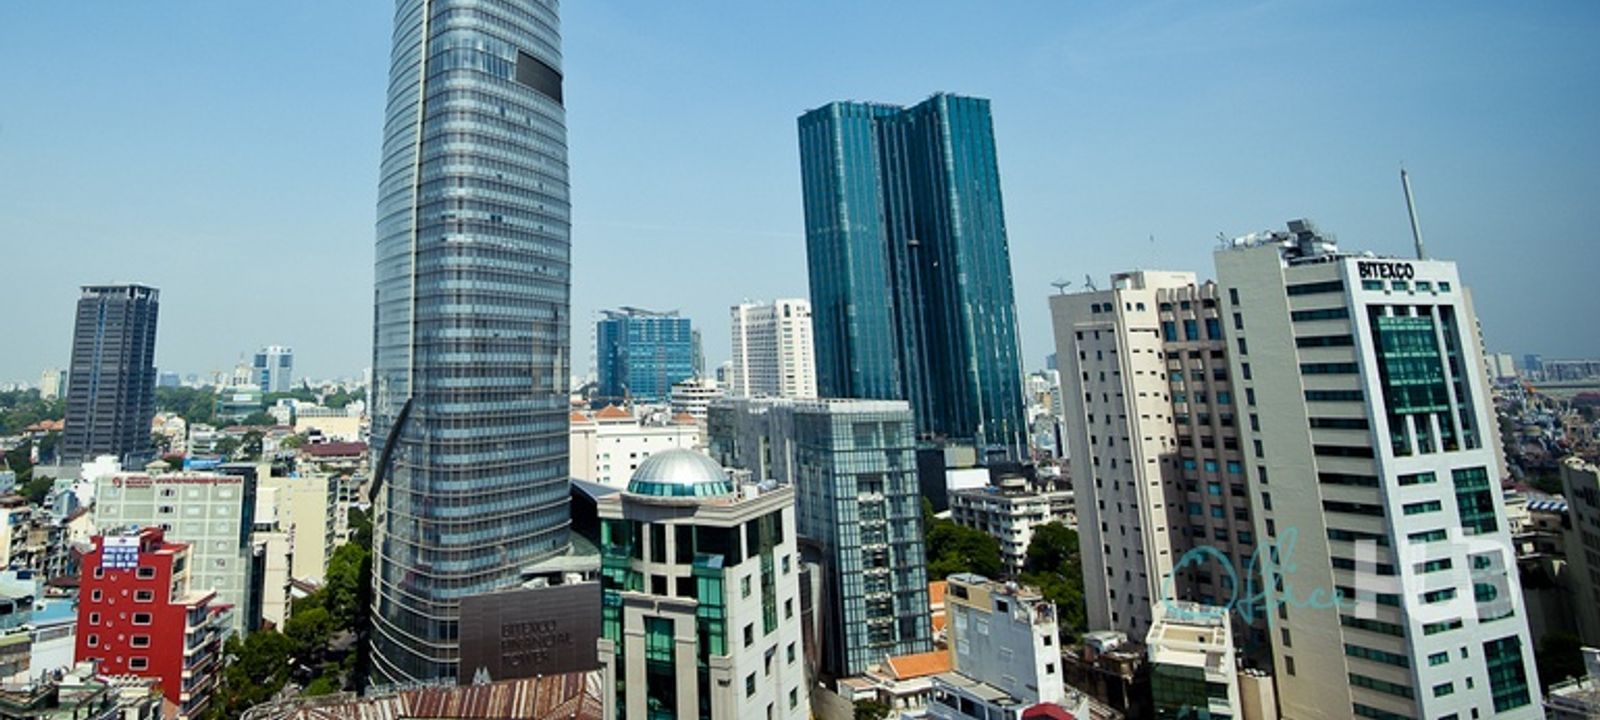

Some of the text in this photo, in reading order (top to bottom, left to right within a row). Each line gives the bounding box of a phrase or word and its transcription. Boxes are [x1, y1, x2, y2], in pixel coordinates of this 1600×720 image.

[1358, 261, 1414, 280] BITEXCO
[501, 620, 557, 638] BITEXCO
[501, 632, 573, 650] FINANCIAL
[502, 650, 551, 667] TOWER
